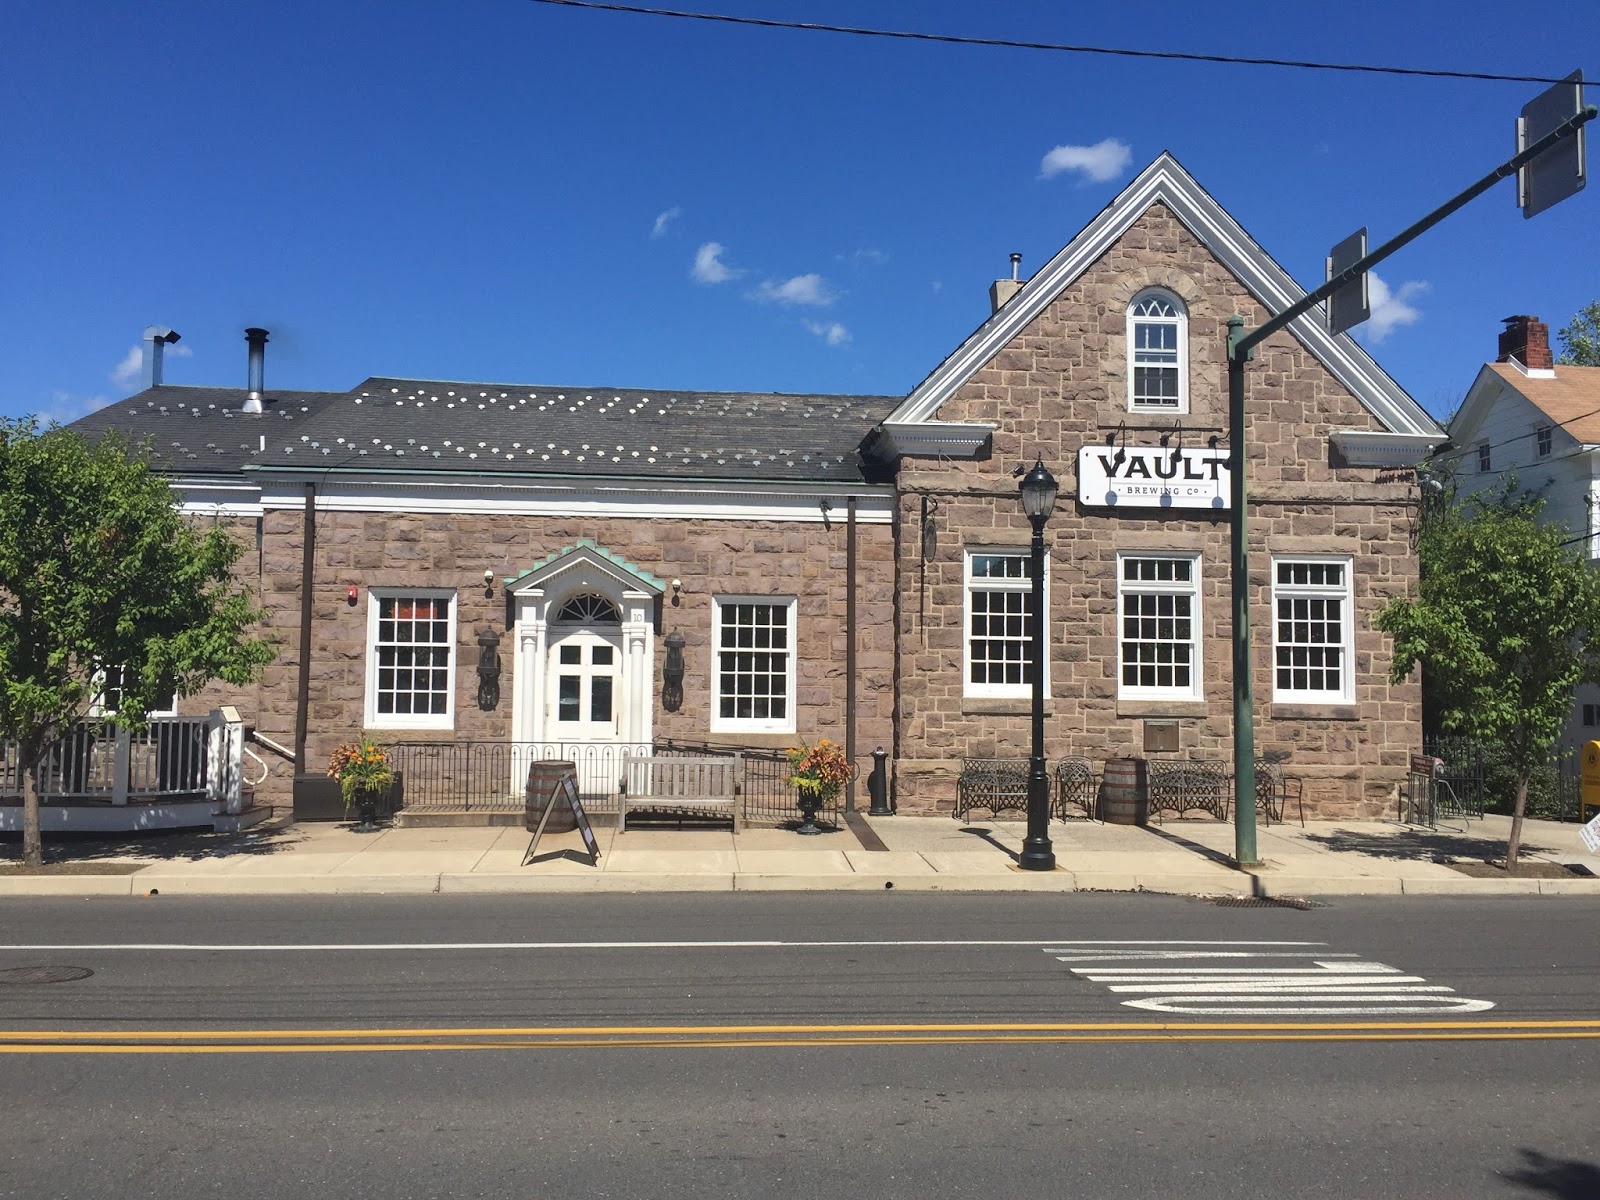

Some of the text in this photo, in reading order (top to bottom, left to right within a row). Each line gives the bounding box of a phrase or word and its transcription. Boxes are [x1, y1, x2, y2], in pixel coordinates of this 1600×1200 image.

[1097, 455, 1226, 480] VAULT
[1127, 486, 1180, 495] BREWING
[633, 613, 643, 622] 10
